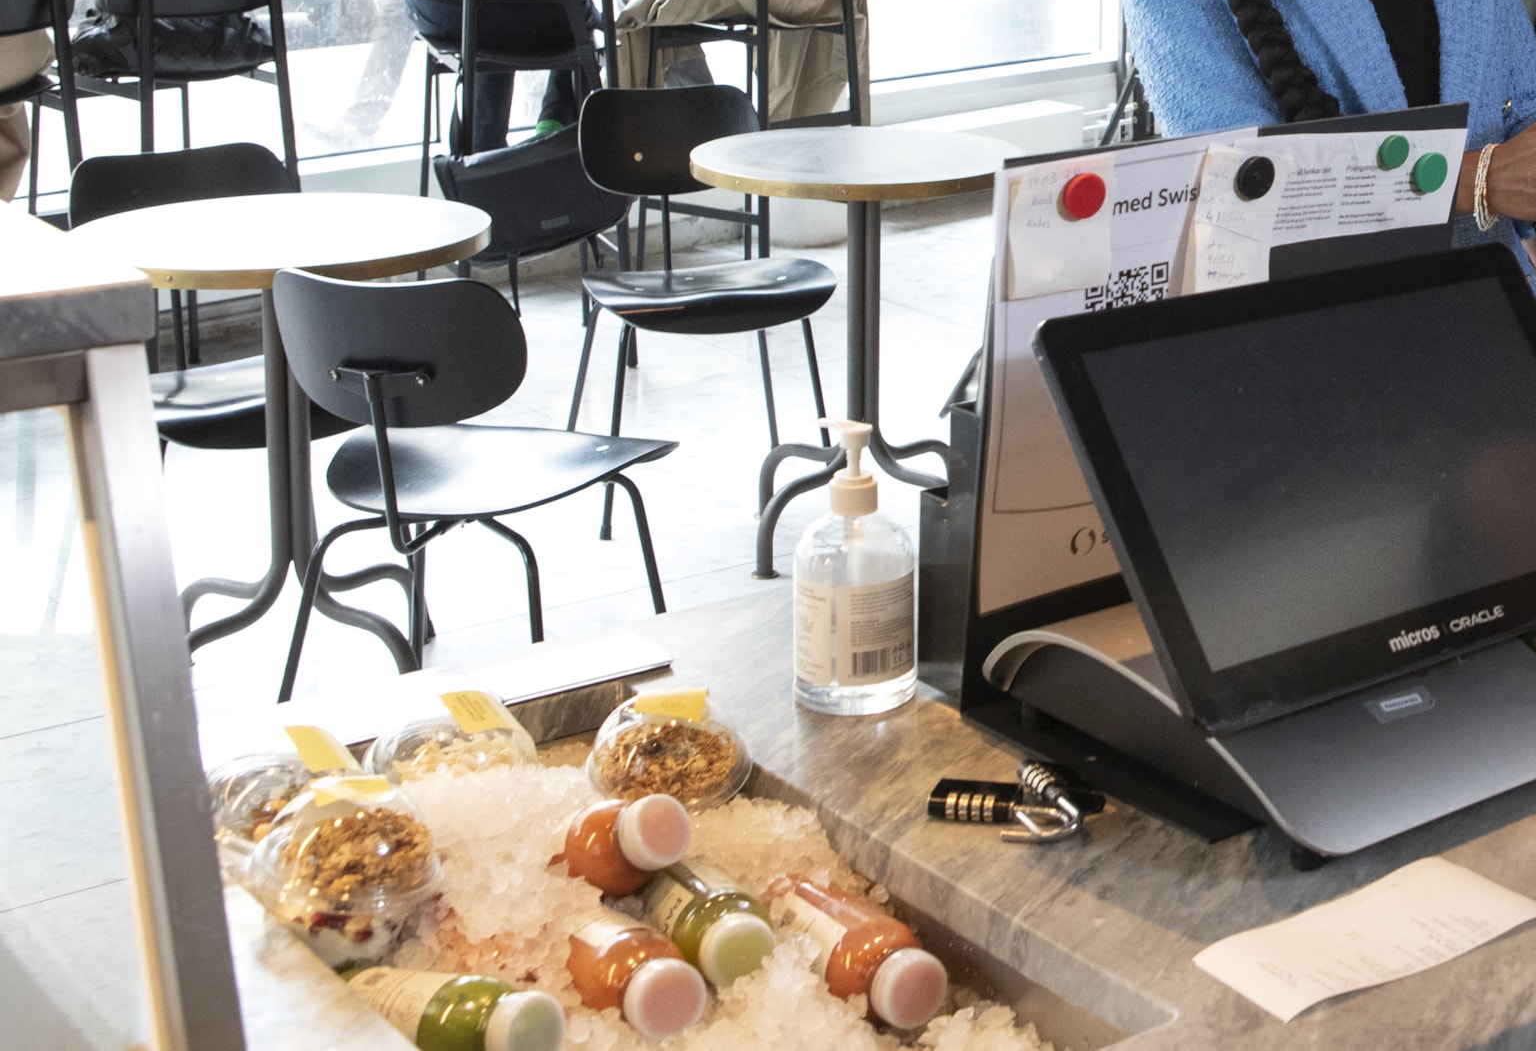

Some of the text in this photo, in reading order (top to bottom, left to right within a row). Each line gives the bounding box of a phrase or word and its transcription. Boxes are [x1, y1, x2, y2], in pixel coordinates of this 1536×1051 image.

[1112, 191, 1152, 216] med
[1388, 604, 1505, 653] micros ORACLE
